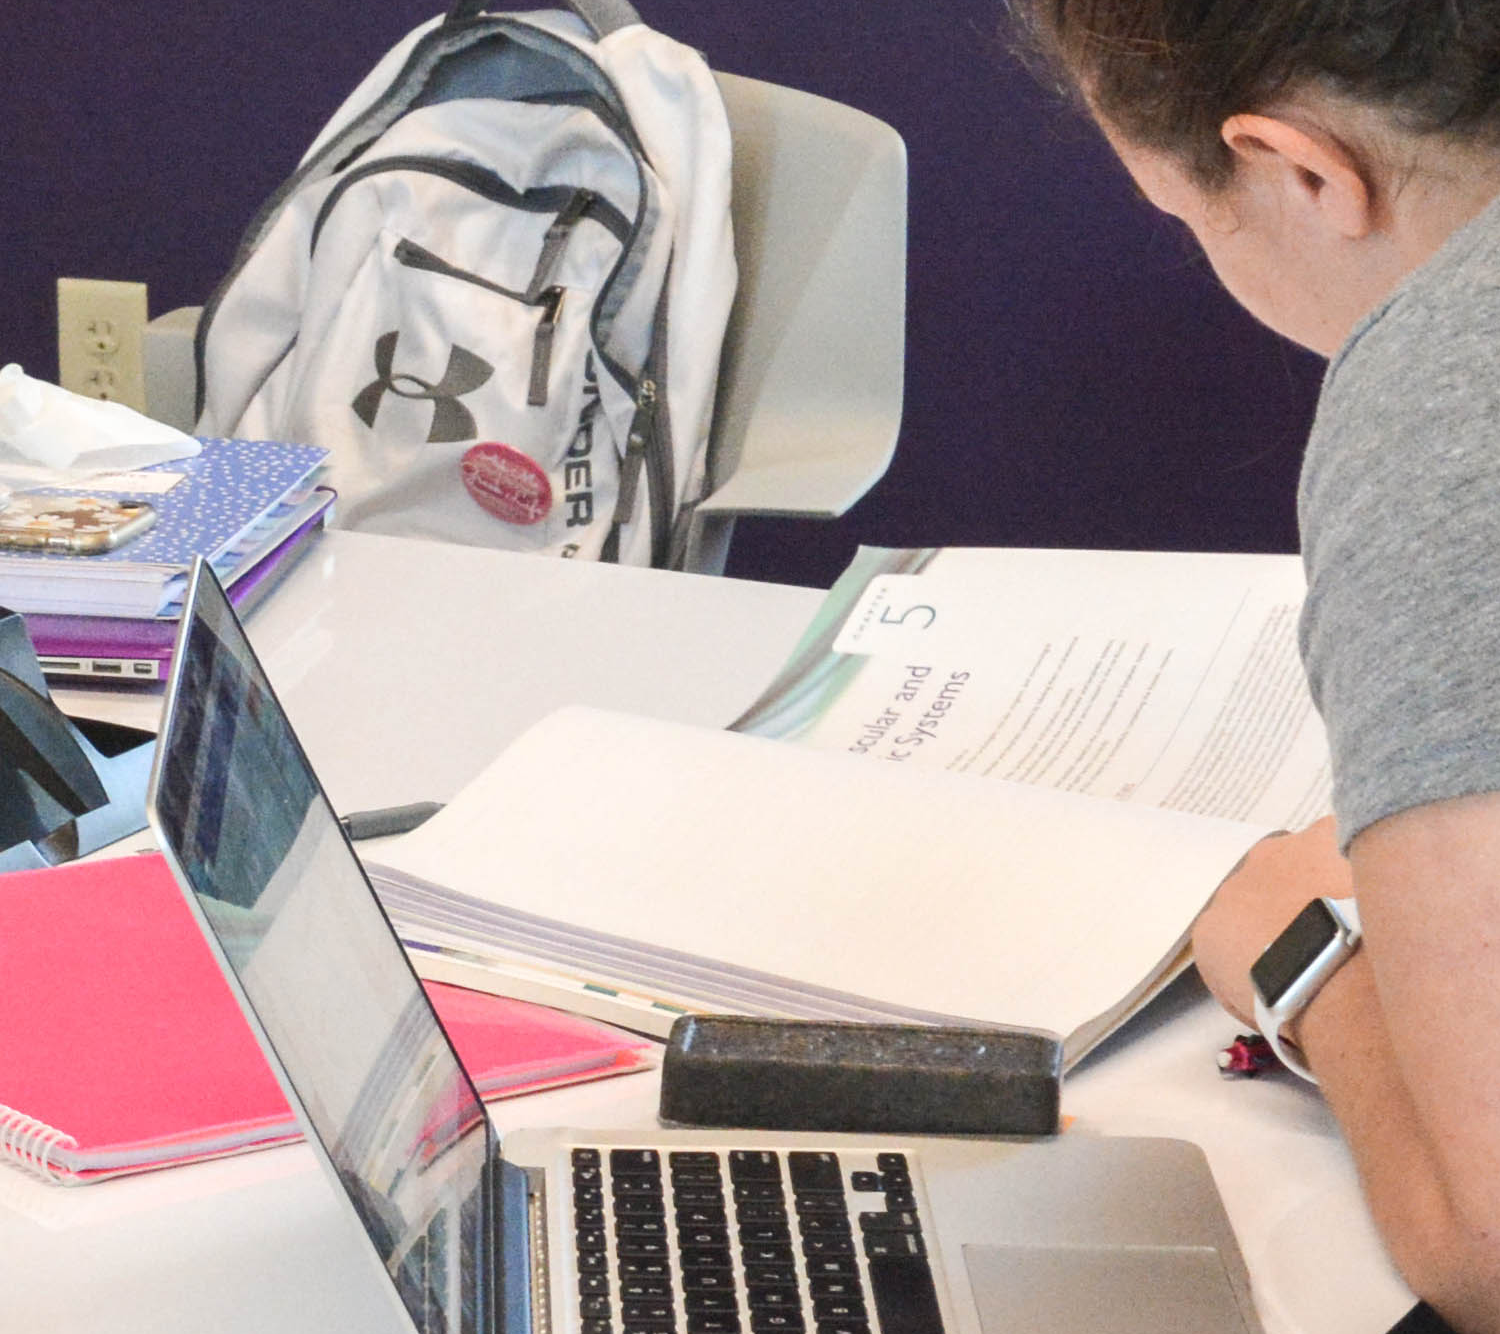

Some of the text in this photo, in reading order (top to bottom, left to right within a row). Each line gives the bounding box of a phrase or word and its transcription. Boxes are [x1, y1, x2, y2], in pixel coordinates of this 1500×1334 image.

[879, 604, 937, 630] 5
[895, 665, 933, 702] and
[894, 670, 971, 747] Systems
